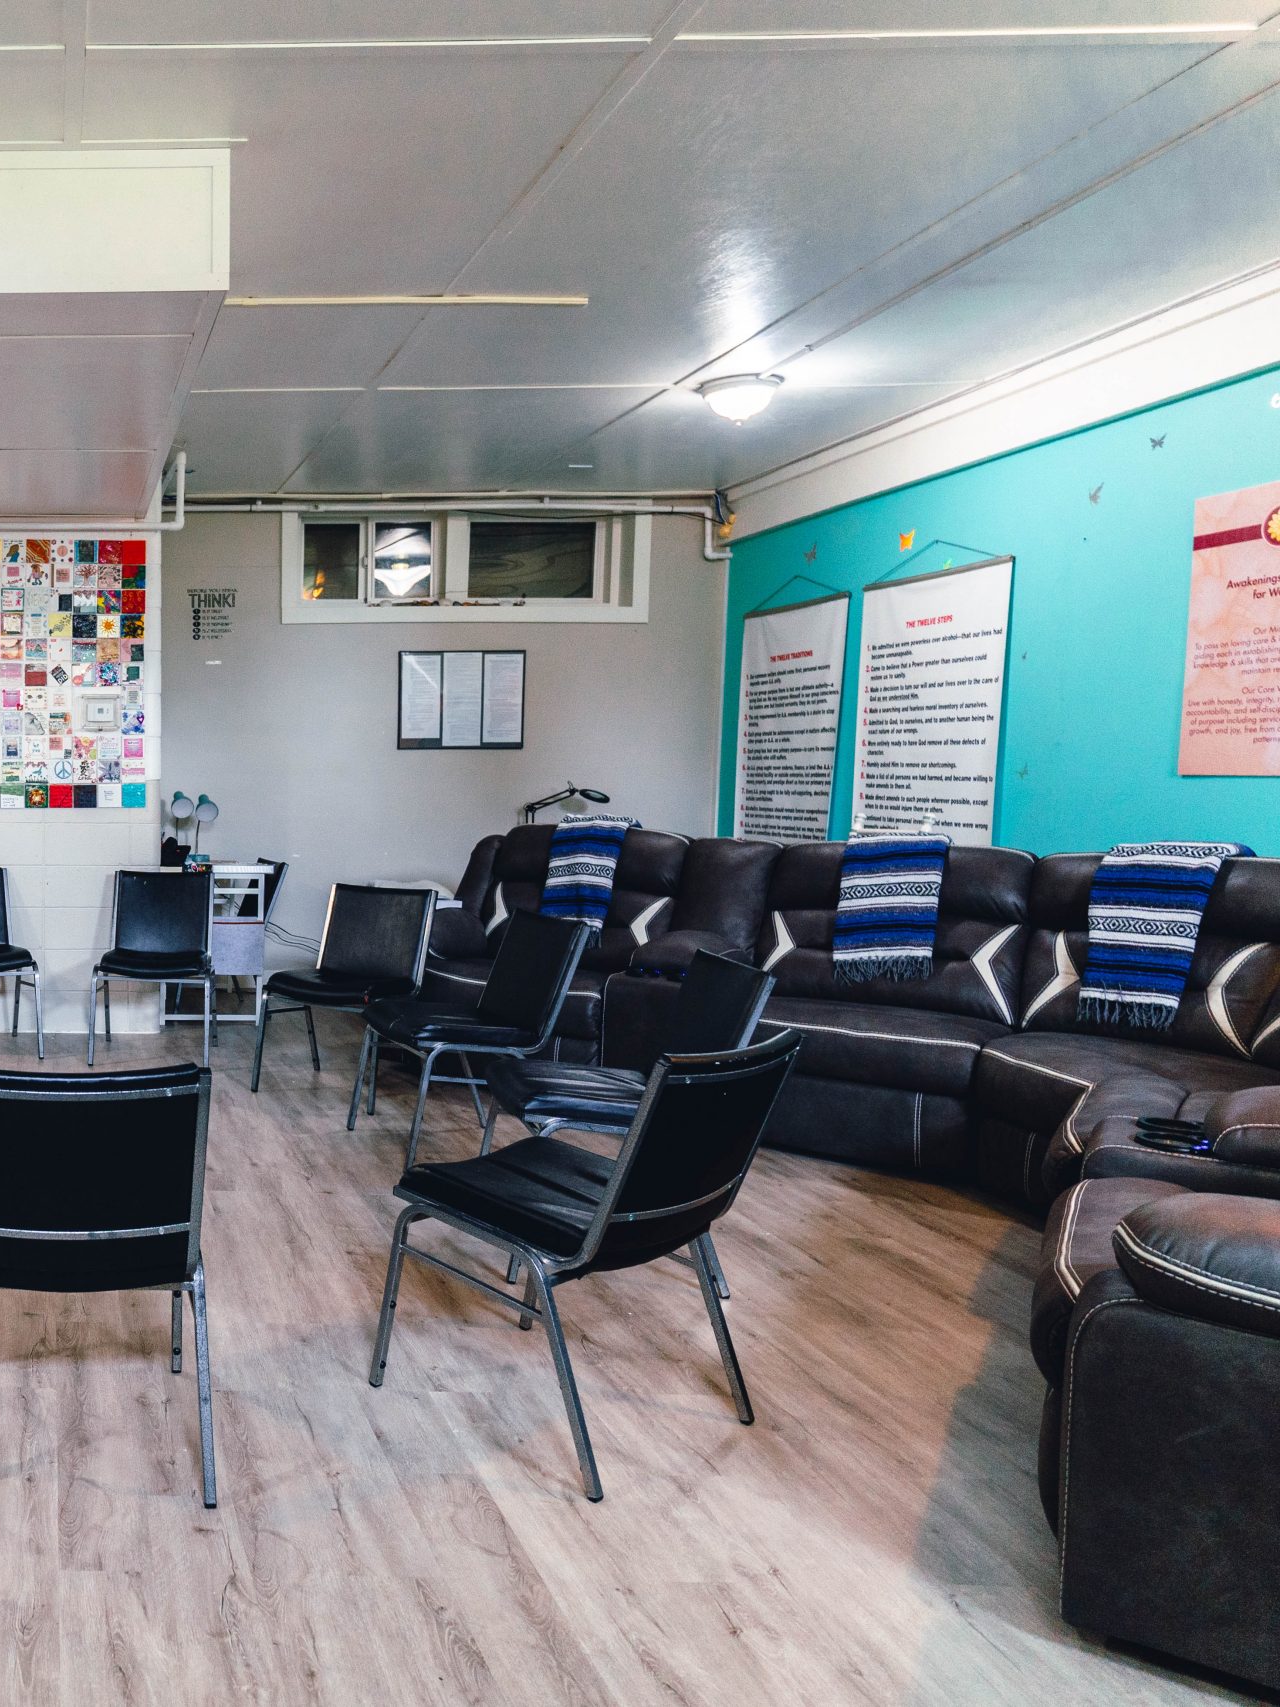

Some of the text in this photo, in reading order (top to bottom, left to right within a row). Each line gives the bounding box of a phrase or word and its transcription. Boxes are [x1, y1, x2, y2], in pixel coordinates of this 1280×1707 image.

[1253, 589, 1266, 599] for
[188, 593, 235, 608] THINK!
[937, 615, 953, 623] STEPS
[1193, 661, 1228, 669] knowledge
[1198, 718, 1224, 727] purpose
[1226, 716, 1256, 725] including
